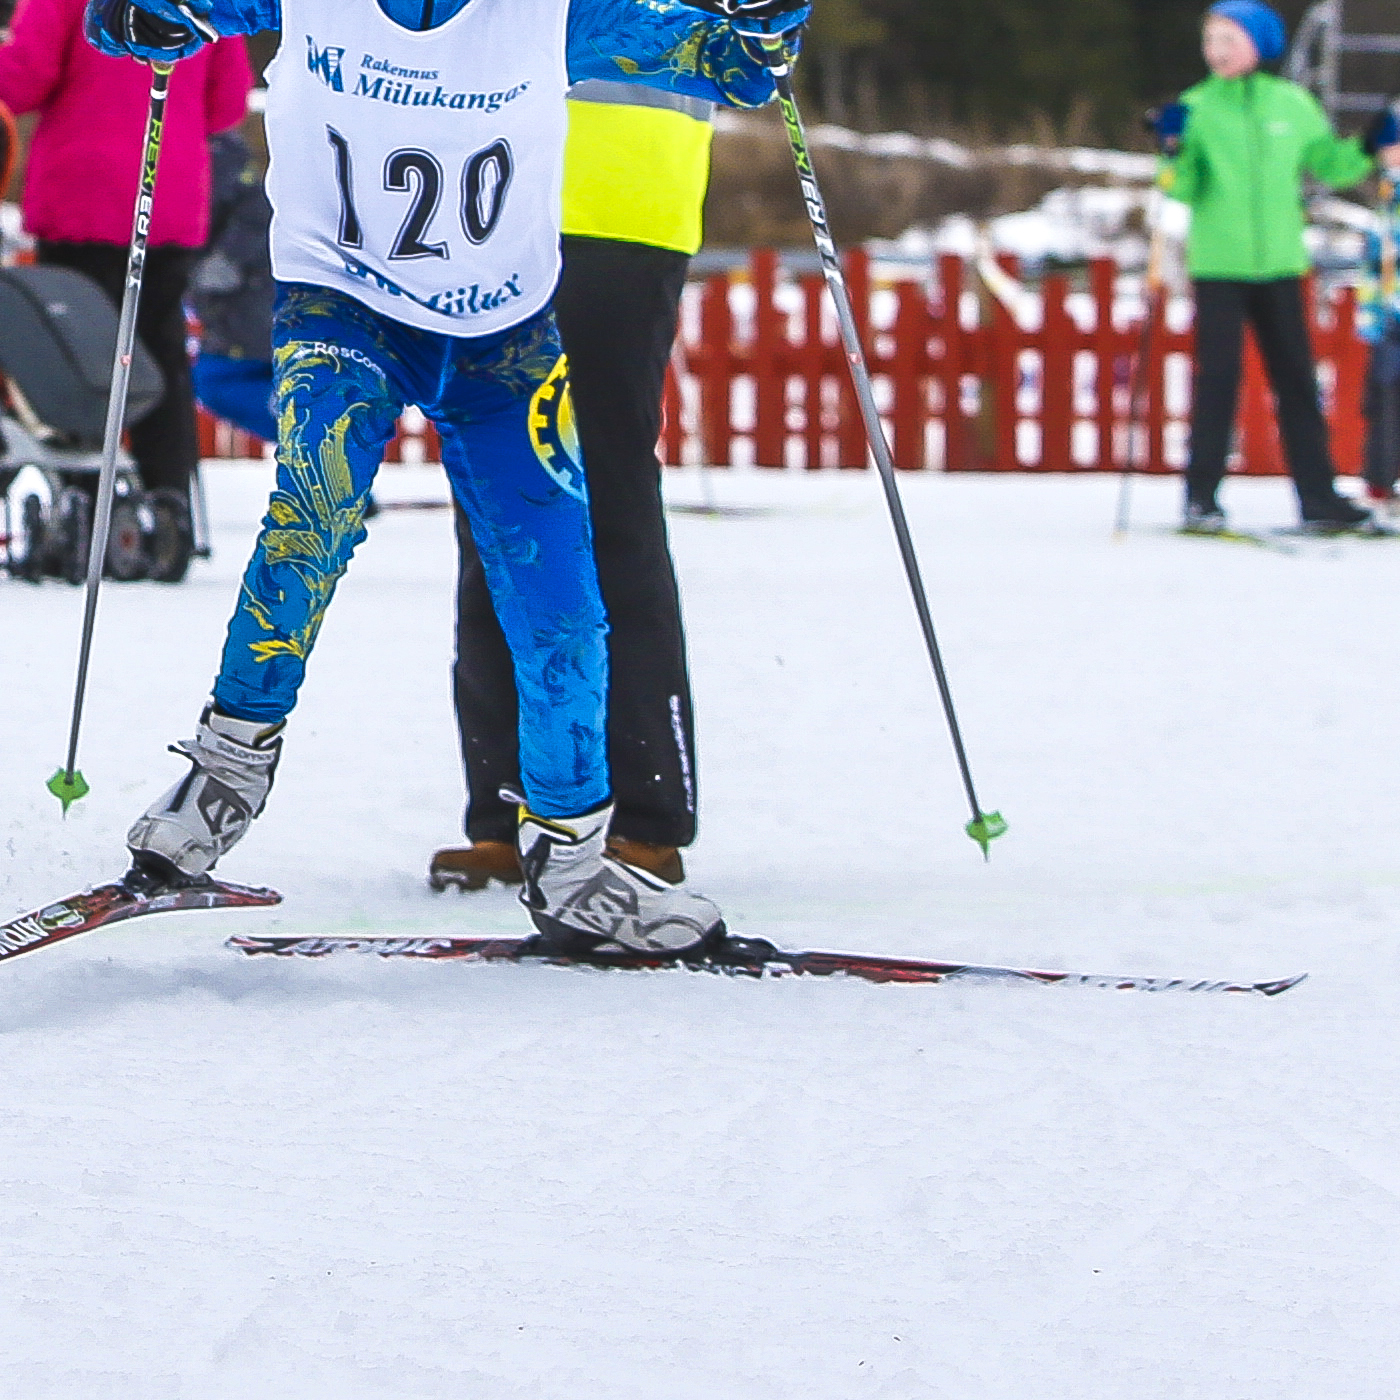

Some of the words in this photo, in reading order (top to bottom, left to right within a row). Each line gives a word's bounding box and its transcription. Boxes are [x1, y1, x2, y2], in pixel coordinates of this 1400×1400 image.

[352, 73, 532, 113] Miilukangas
[360, 53, 439, 80] Rakennus
[145, 118, 163, 186] REX
[780, 98, 811, 171] REX
[325, 122, 515, 261] 120
